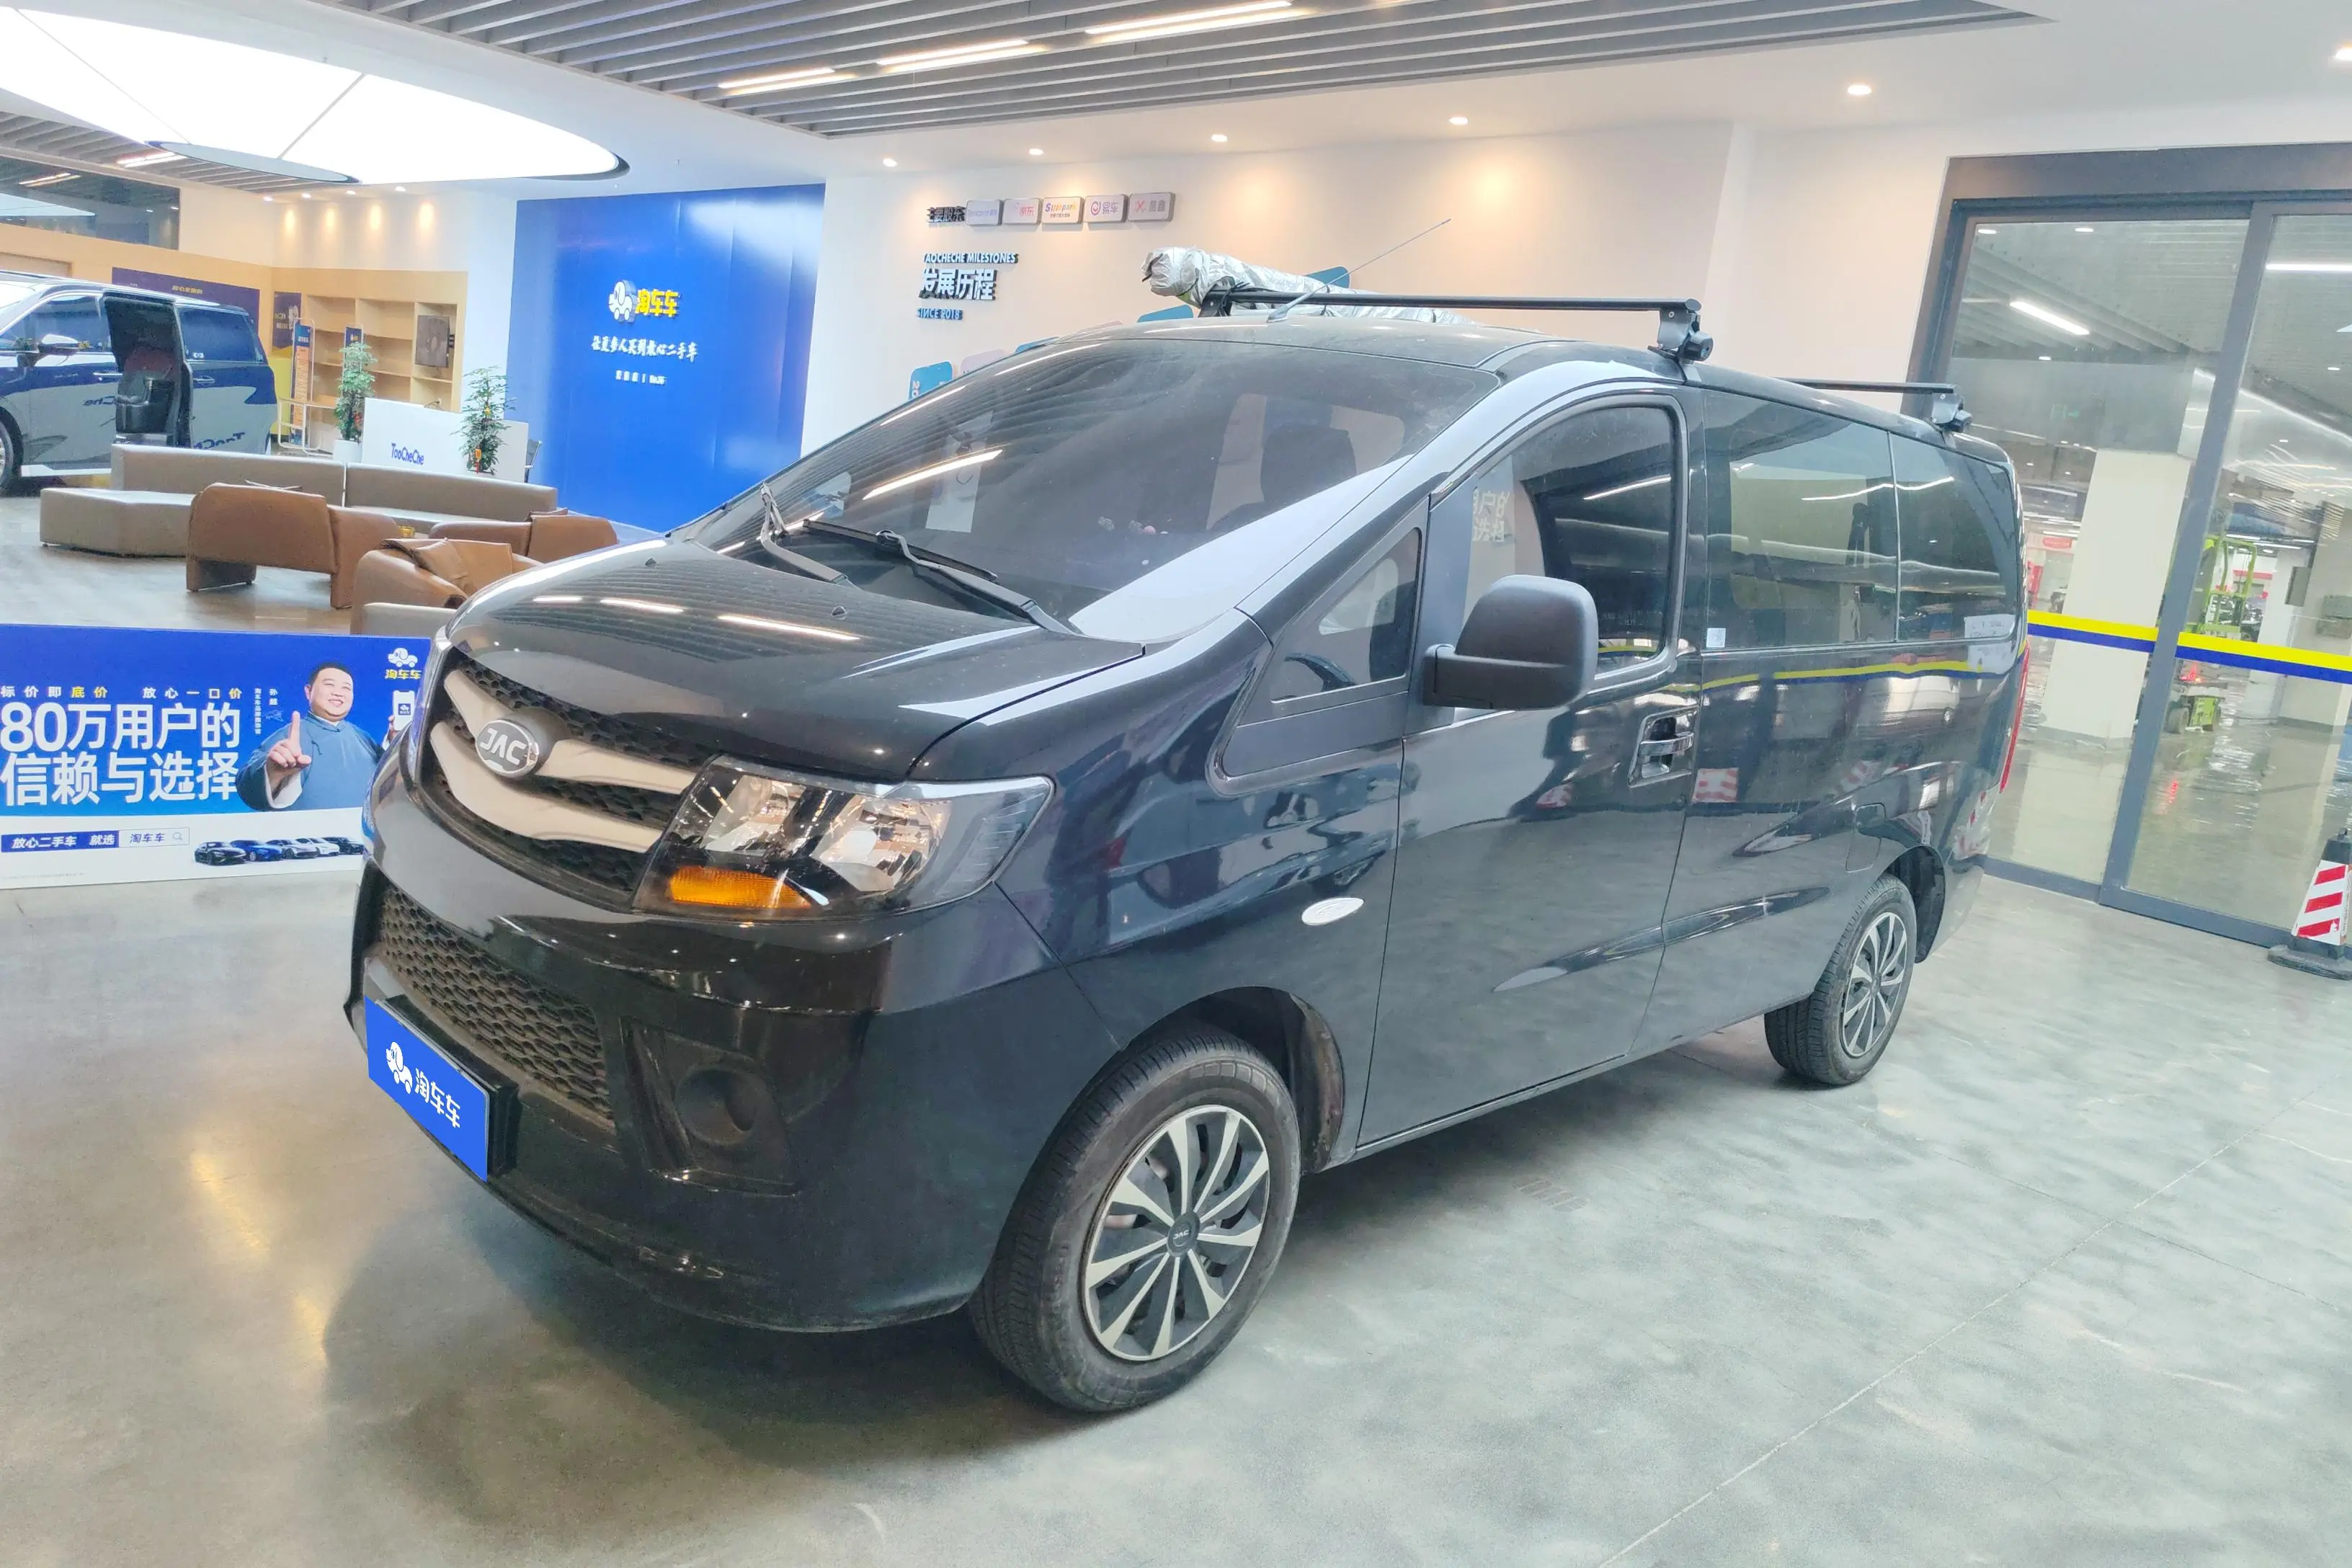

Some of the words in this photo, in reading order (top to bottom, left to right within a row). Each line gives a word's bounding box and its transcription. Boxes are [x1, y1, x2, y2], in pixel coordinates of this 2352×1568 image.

[967, 253, 1017, 264] MILESTONES
[919, 267, 996, 300] 发展历程
[635, 288, 680, 318] 淘车车
[917, 308, 939, 319] SINCE
[940, 308, 963, 320] 2018
[385, 669, 422, 680] 淘车车
[1, 685, 108, 698] 标价即底价
[143, 687, 243, 700] 放心一口价
[1, 701, 241, 752] 80万用户的
[479, 727, 527, 766] JAC
[0, 750, 239, 807] 信赖与选择
[12, 836, 77, 850] 放心二手车
[89, 834, 115, 846] 就选
[130, 832, 166, 845] 淘车车
[414, 1067, 461, 1129] 淘车车
[1172, 1229, 1190, 1240] JAC
